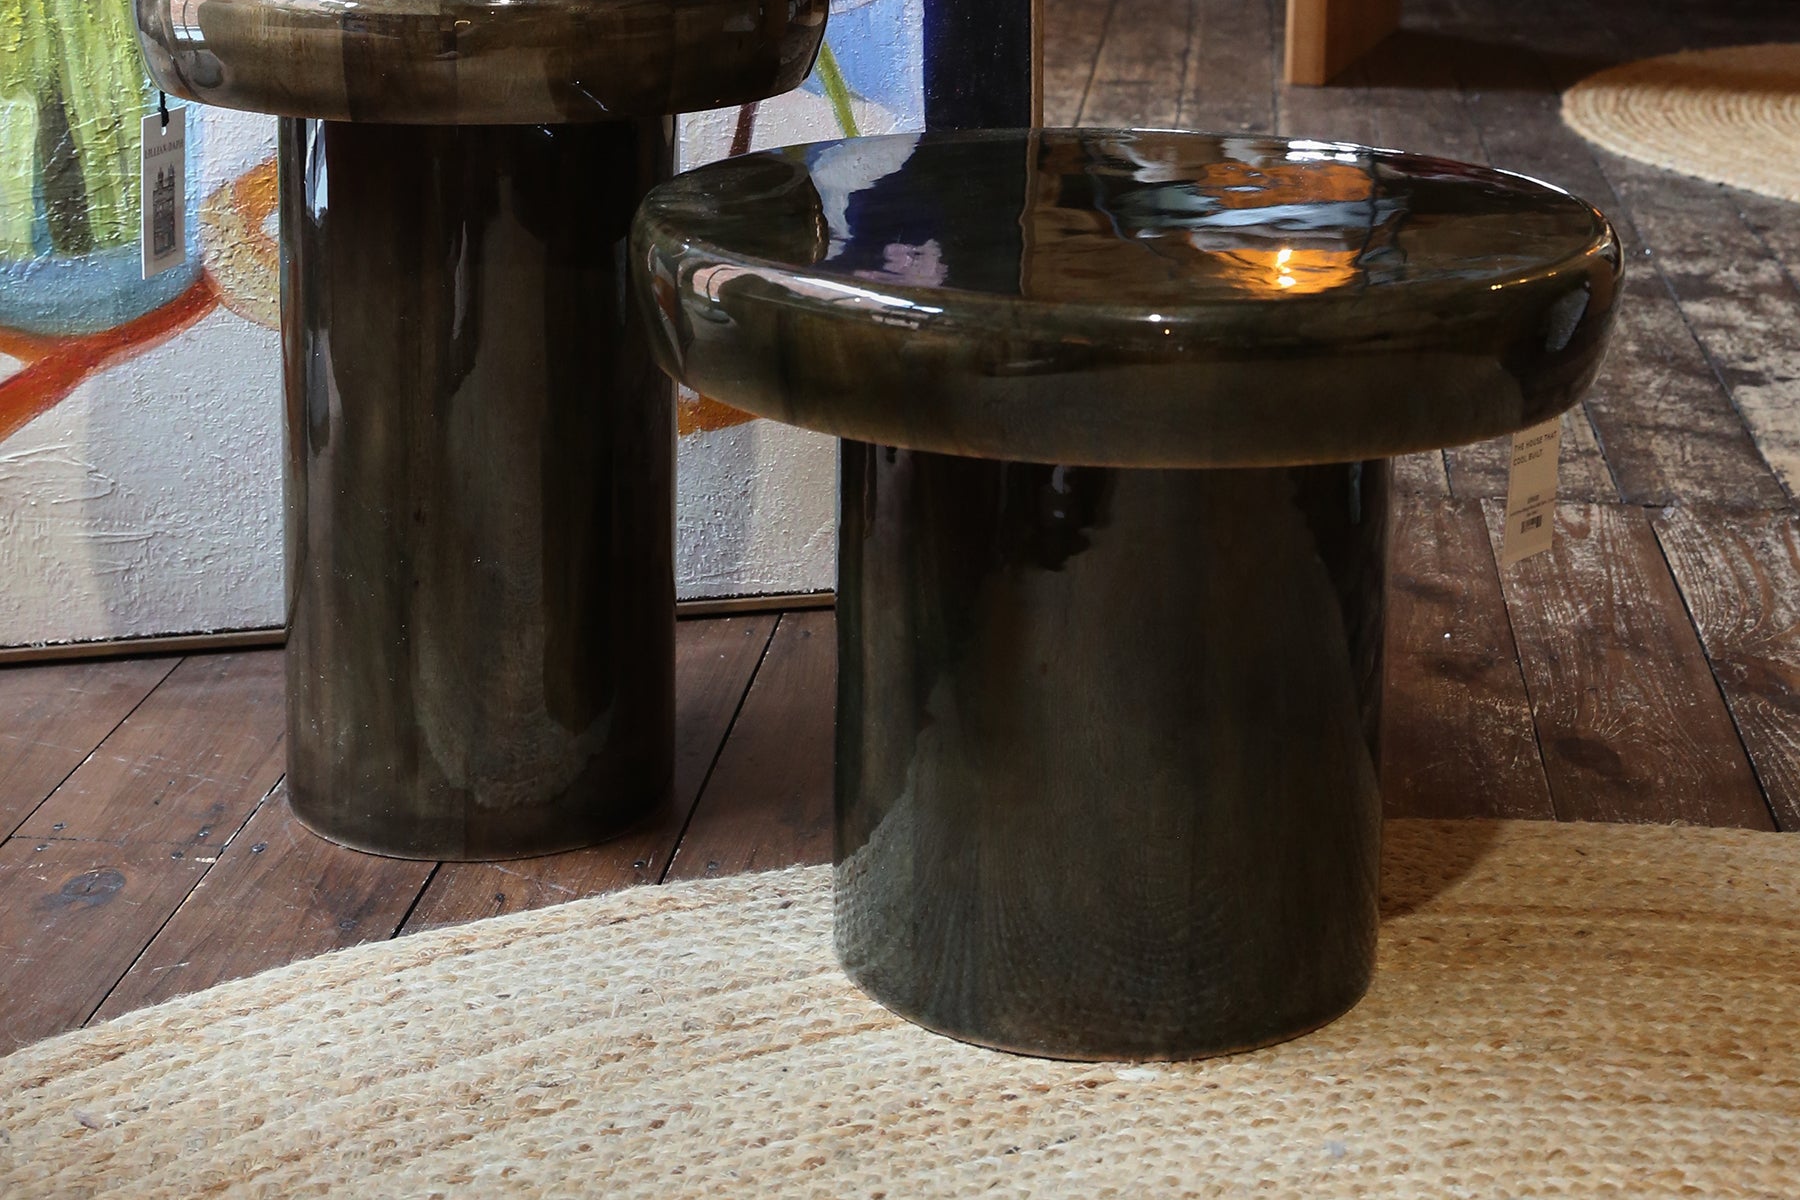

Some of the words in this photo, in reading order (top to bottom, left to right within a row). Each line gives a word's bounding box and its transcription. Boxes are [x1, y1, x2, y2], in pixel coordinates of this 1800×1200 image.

[1514, 443, 1524, 452] THE
[1526, 435, 1543, 448] HOUSE
[1544, 430, 1557, 442] THAT
[1513, 455, 1528, 466] COOL
[1528, 449, 1543, 460] BUILT
